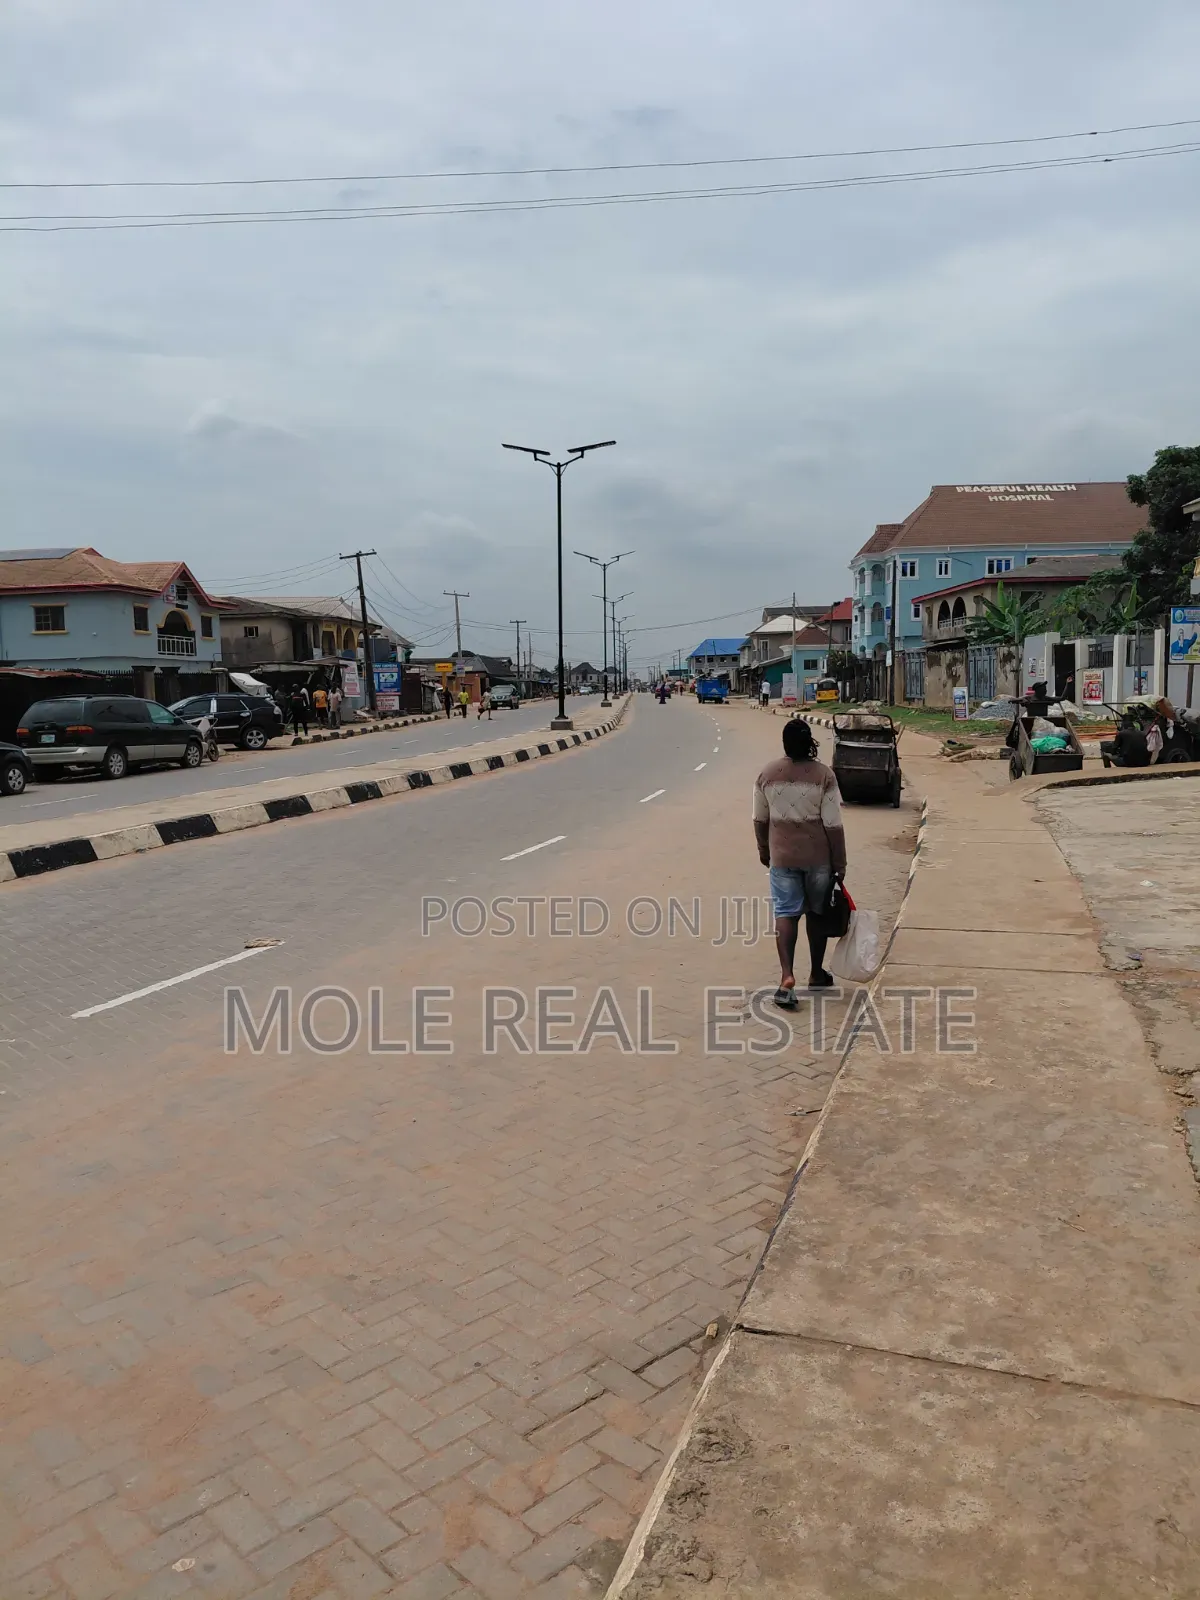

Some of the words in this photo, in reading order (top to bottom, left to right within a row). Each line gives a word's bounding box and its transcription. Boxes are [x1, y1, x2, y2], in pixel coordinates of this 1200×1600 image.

[955, 485, 1025, 493] PEACEFUL
[1025, 484, 1077, 492] HEALTH
[988, 494, 1055, 502] HOSPITAL
